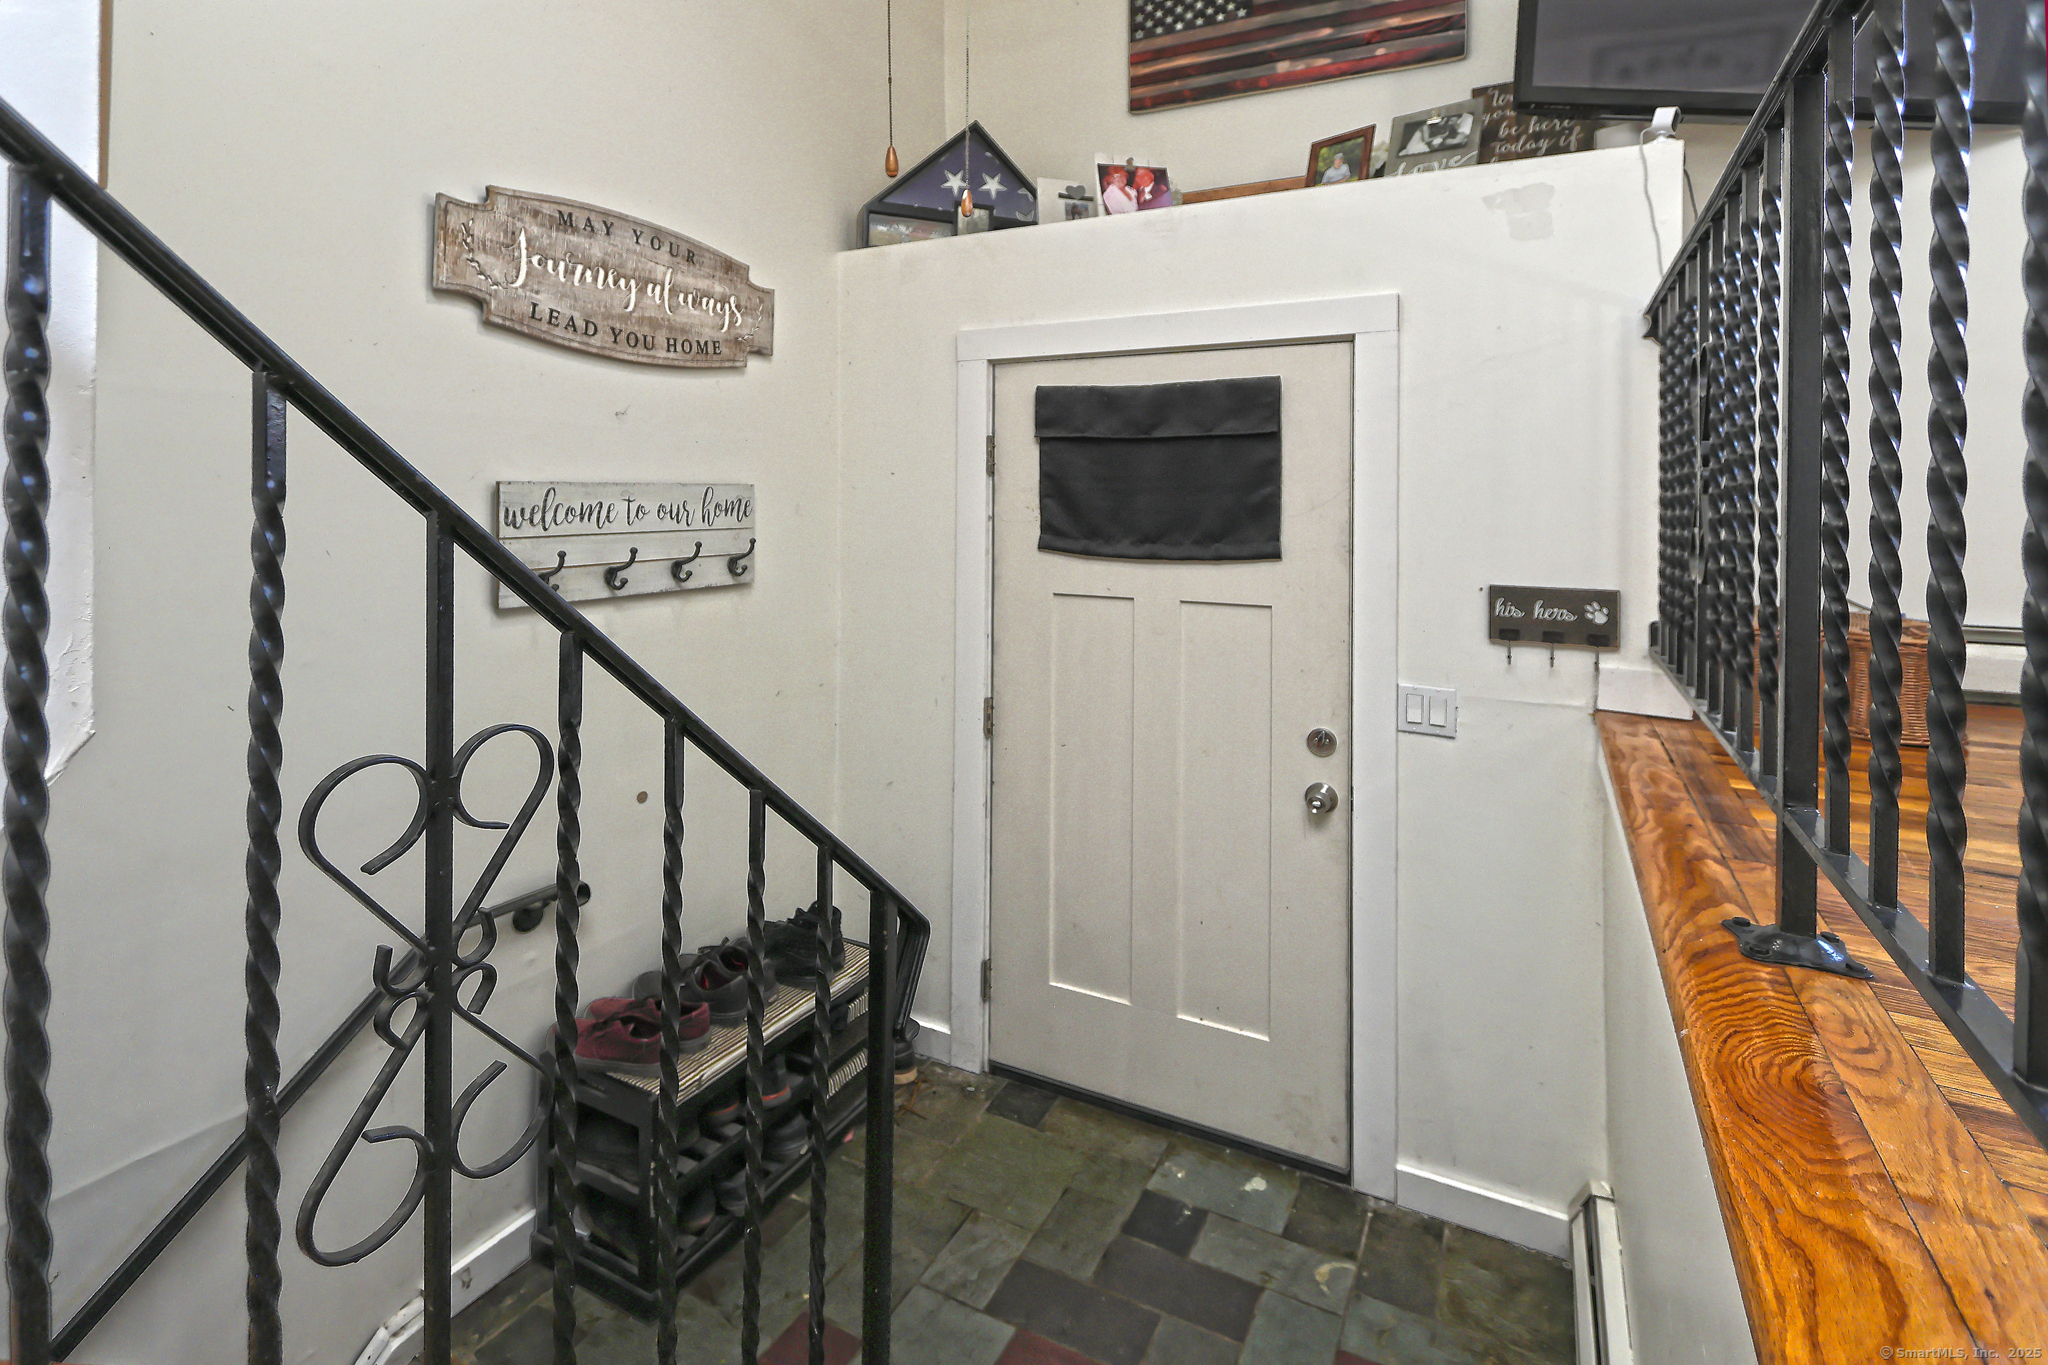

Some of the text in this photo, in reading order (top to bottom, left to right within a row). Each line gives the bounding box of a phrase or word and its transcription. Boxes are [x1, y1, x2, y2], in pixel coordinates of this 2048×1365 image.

[1498, 115, 1576, 139] be here
[1559, 126, 1585, 151] if
[556, 209, 697, 265] MAY YOUR
[502, 227, 744, 333] Journey always
[530, 302, 723, 356] LEAD YOU HOME
[503, 486, 753, 531] welcome to our home
[1494, 597, 1578, 622] his hers
